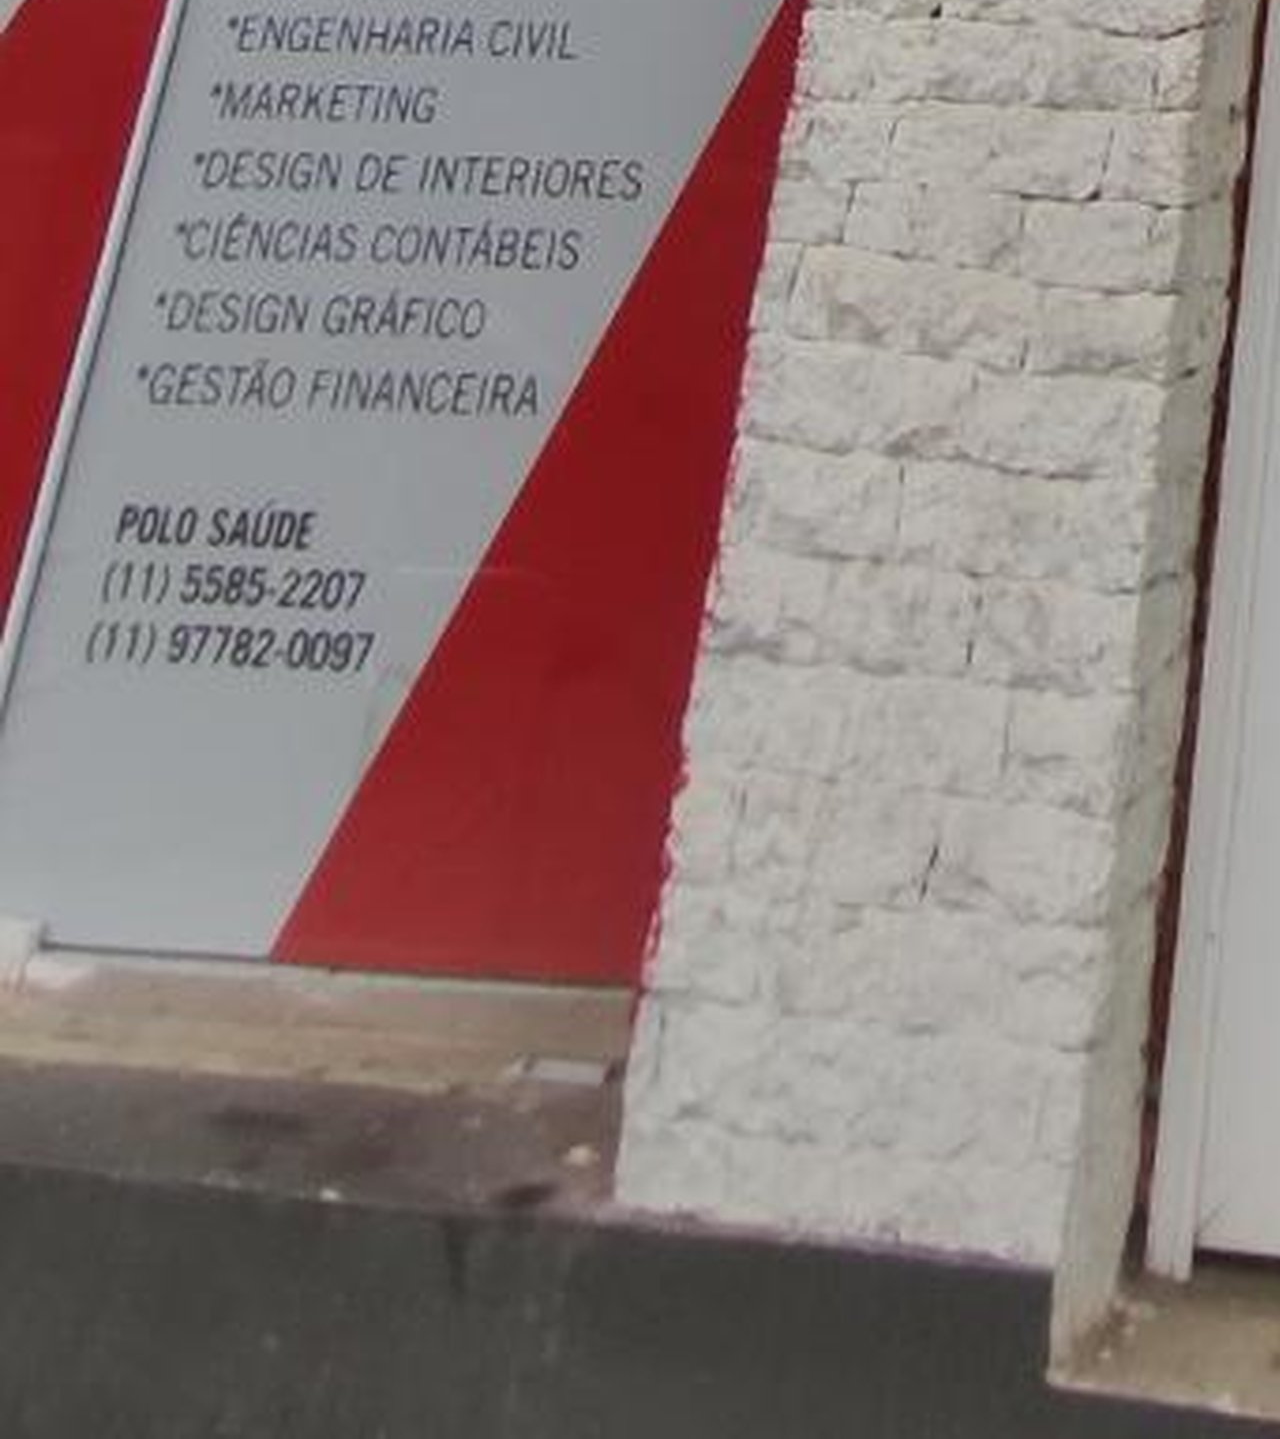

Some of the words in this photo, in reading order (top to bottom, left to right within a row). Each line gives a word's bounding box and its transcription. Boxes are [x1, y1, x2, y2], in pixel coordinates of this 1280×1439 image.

[487, 20, 580, 61] CIVIL
[355, 154, 405, 195] DE
[418, 156, 645, 202] INTERIORES
[370, 221, 584, 271] CONTÁBEIS
[321, 291, 487, 339] GRÁFICO
[307, 371, 541, 416] FINANCEIRA
[116, 505, 198, 545] POLO
[207, 498, 317, 550] SAÚDE
[102, 562, 170, 604] (11)
[180, 564, 367, 610] 5585-2207
[86, 621, 157, 665] (11)
[167, 625, 376, 672] 97782-0097
